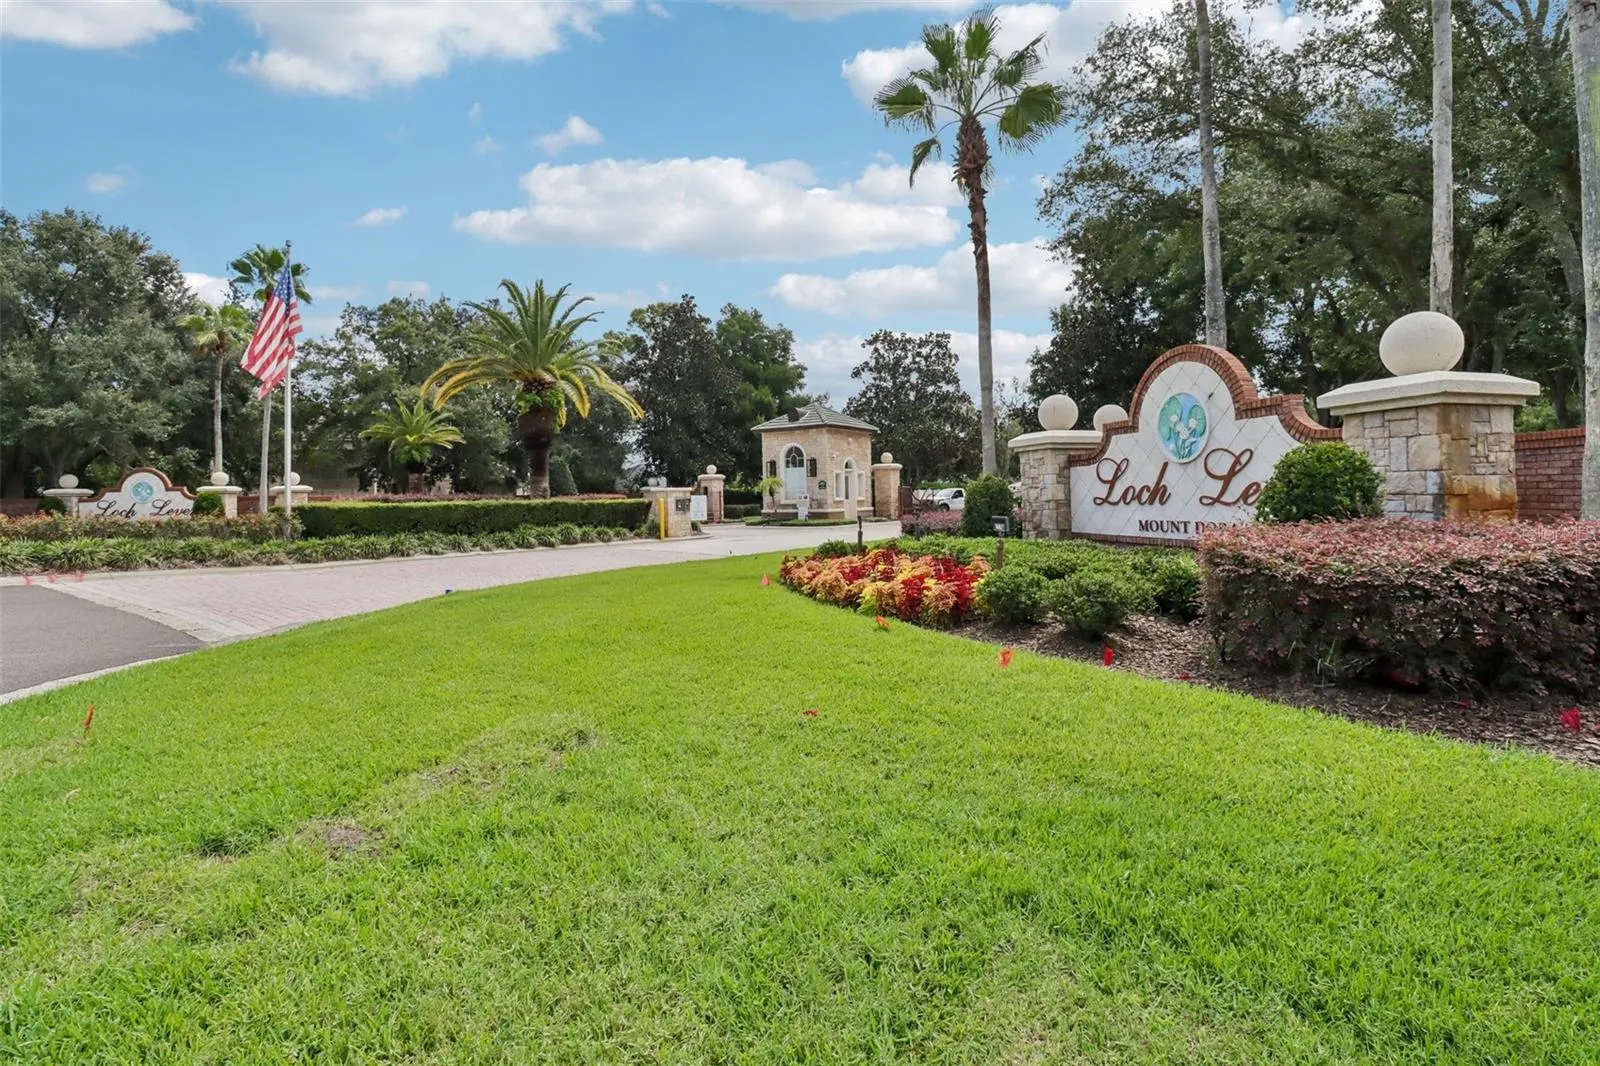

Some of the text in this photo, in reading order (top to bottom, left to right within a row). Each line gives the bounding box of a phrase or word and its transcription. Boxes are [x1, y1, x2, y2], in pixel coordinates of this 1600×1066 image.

[1093, 448, 1262, 506] Loch Le
[96, 499, 137, 520] Loch
[1138, 519, 1191, 535] MOUNT
